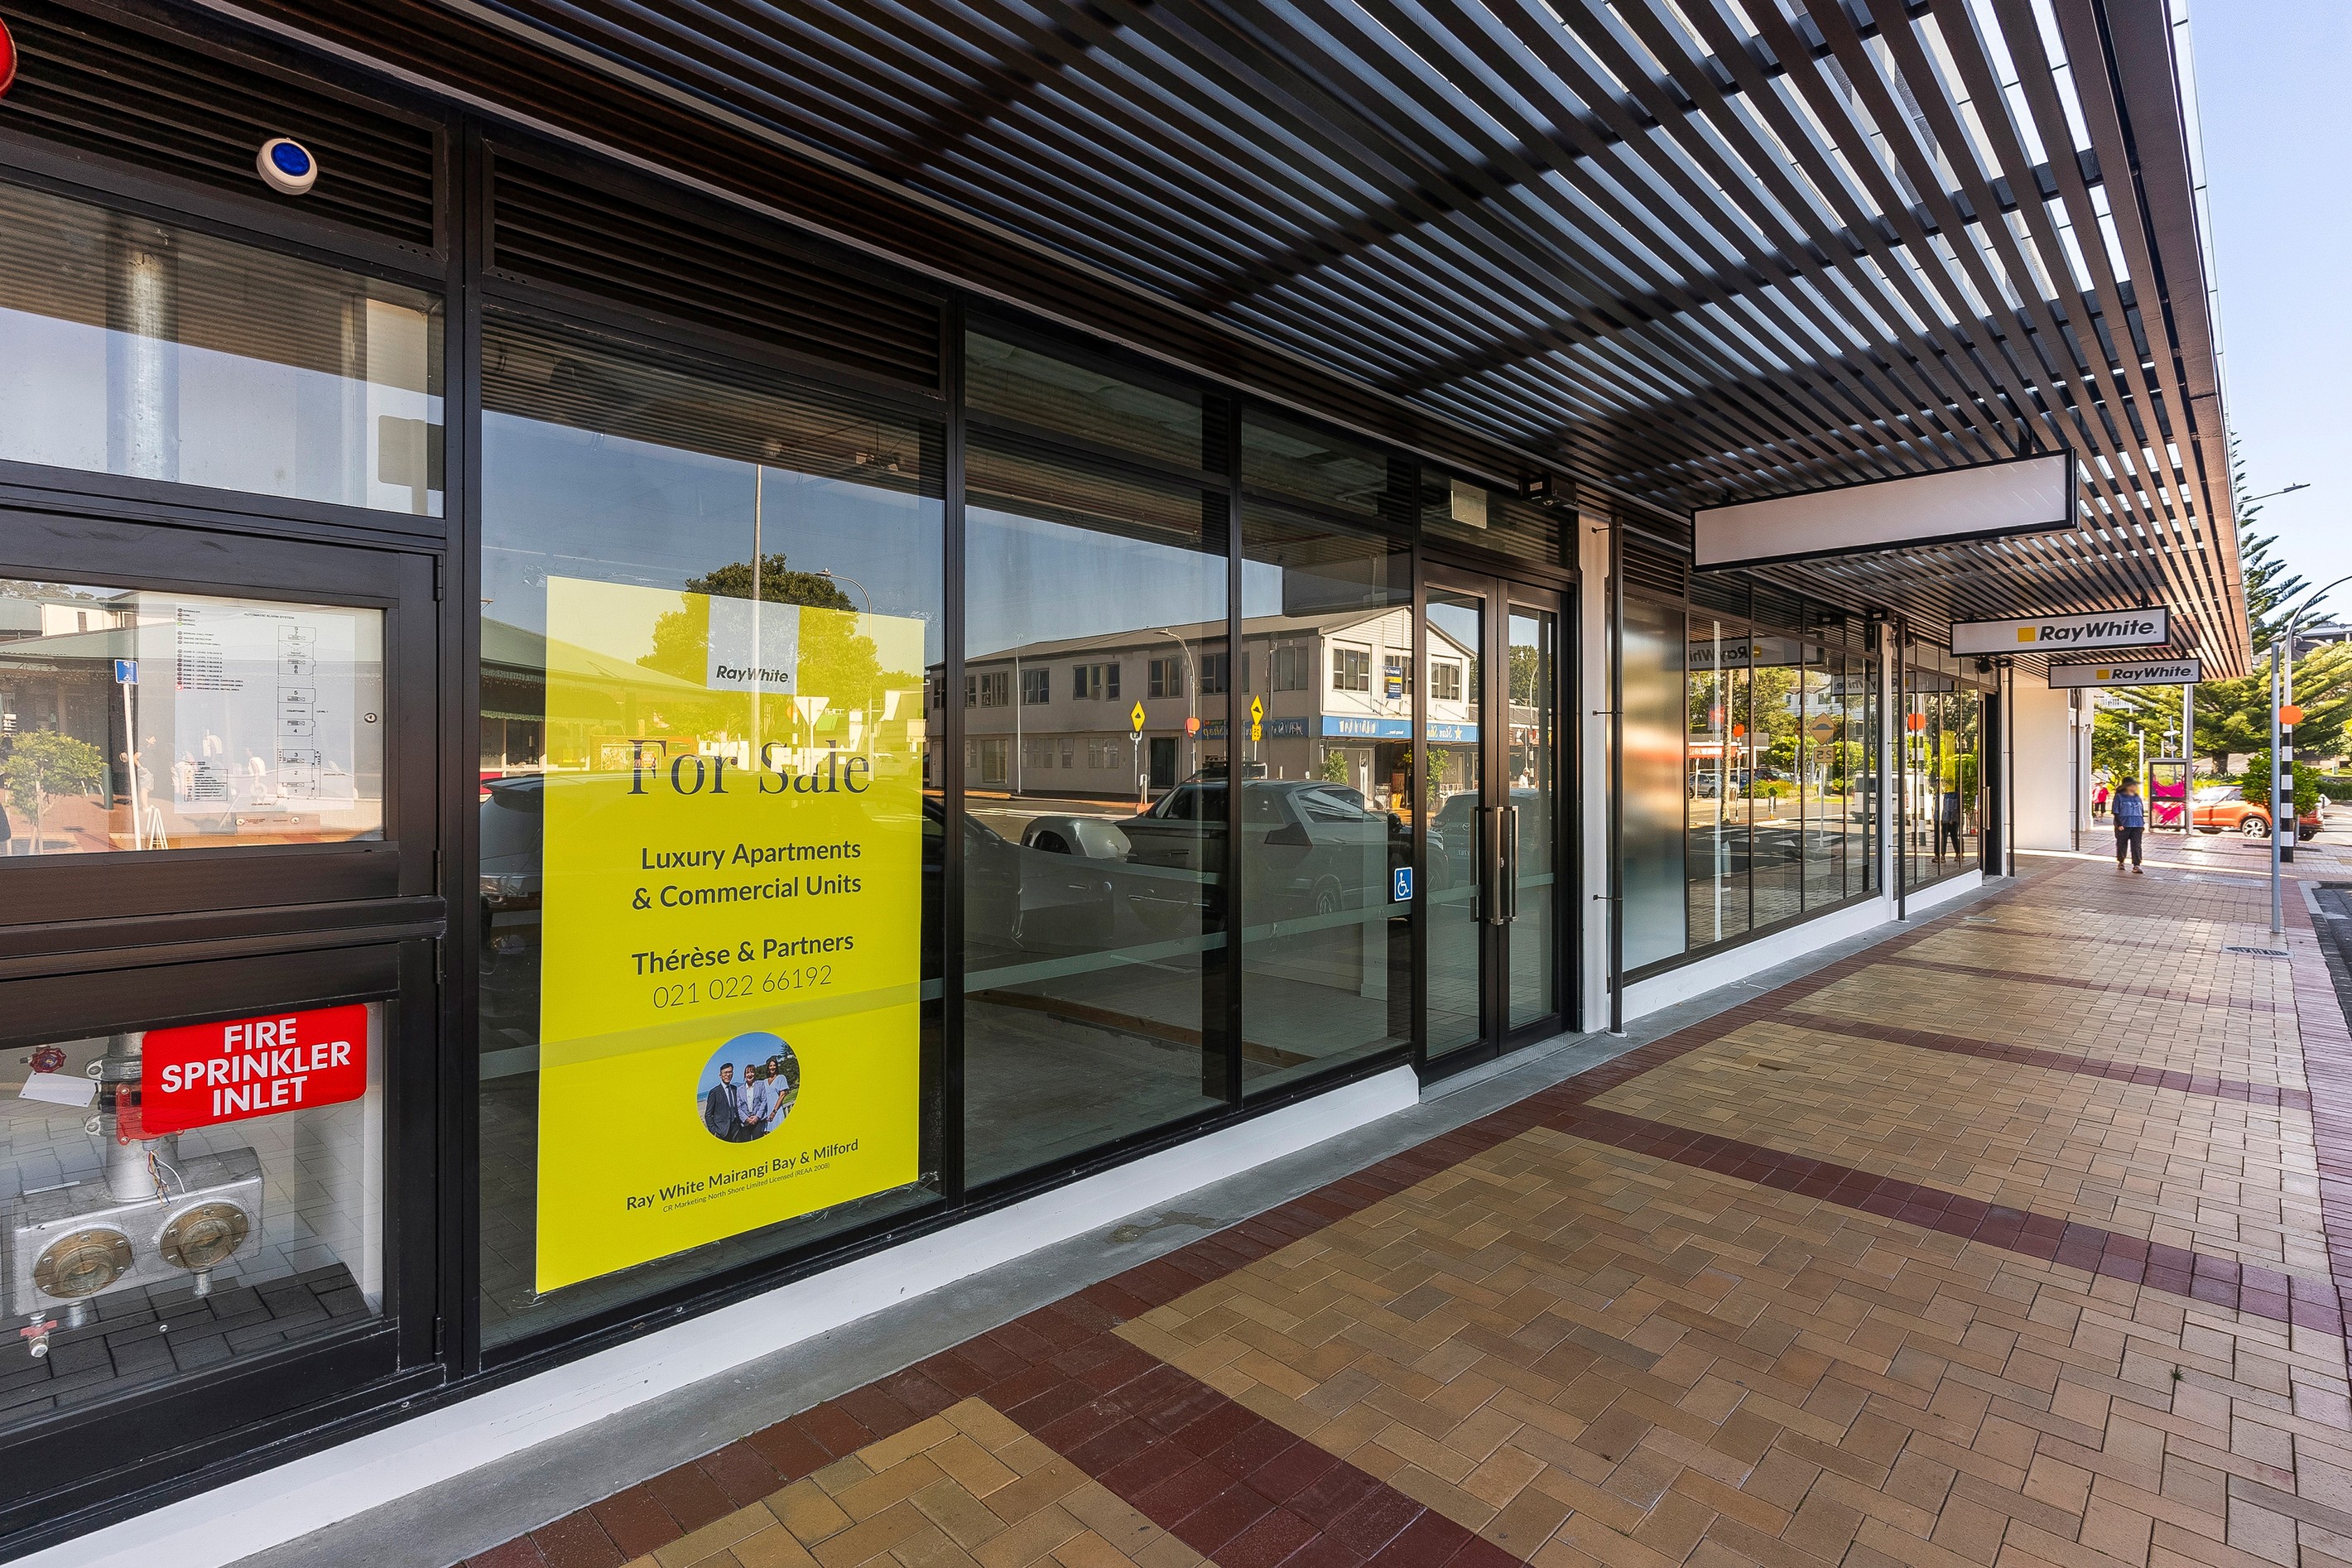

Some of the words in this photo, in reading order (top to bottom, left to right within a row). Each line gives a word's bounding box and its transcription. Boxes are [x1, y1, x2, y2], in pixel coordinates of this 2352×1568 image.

[627, 739, 738, 796] For
[758, 739, 870, 795] Sale
[642, 845, 725, 871] Luxury
[732, 839, 862, 865] Apartments
[632, 887, 652, 911] &
[660, 876, 800, 907] Commercial
[805, 873, 862, 896] Units
[632, 945, 730, 976] Thérèse
[737, 941, 756, 962] &
[762, 934, 854, 960] Partners
[653, 982, 700, 1009] 021
[709, 974, 753, 1001] 022
[762, 964, 832, 993] 66192
[224, 1017, 296, 1053] FIRE
[161, 1041, 352, 1094] SPRINKLER
[213, 1075, 308, 1117] INLET
[626, 1194, 656, 1210] Ray
[659, 1180, 705, 1201] White
[709, 1162, 768, 1189] Mairangi
[772, 1157, 796, 1174] Bay
[800, 1151, 810, 1164] &
[814, 1139, 859, 1161] Milford
[675, 1195, 707, 1209] Marketing
[708, 1191, 727, 1200] North
[728, 1186, 745, 1195] Shore
[747, 1179, 768, 1190] Limited
[769, 1172, 793, 1184] Licensed
